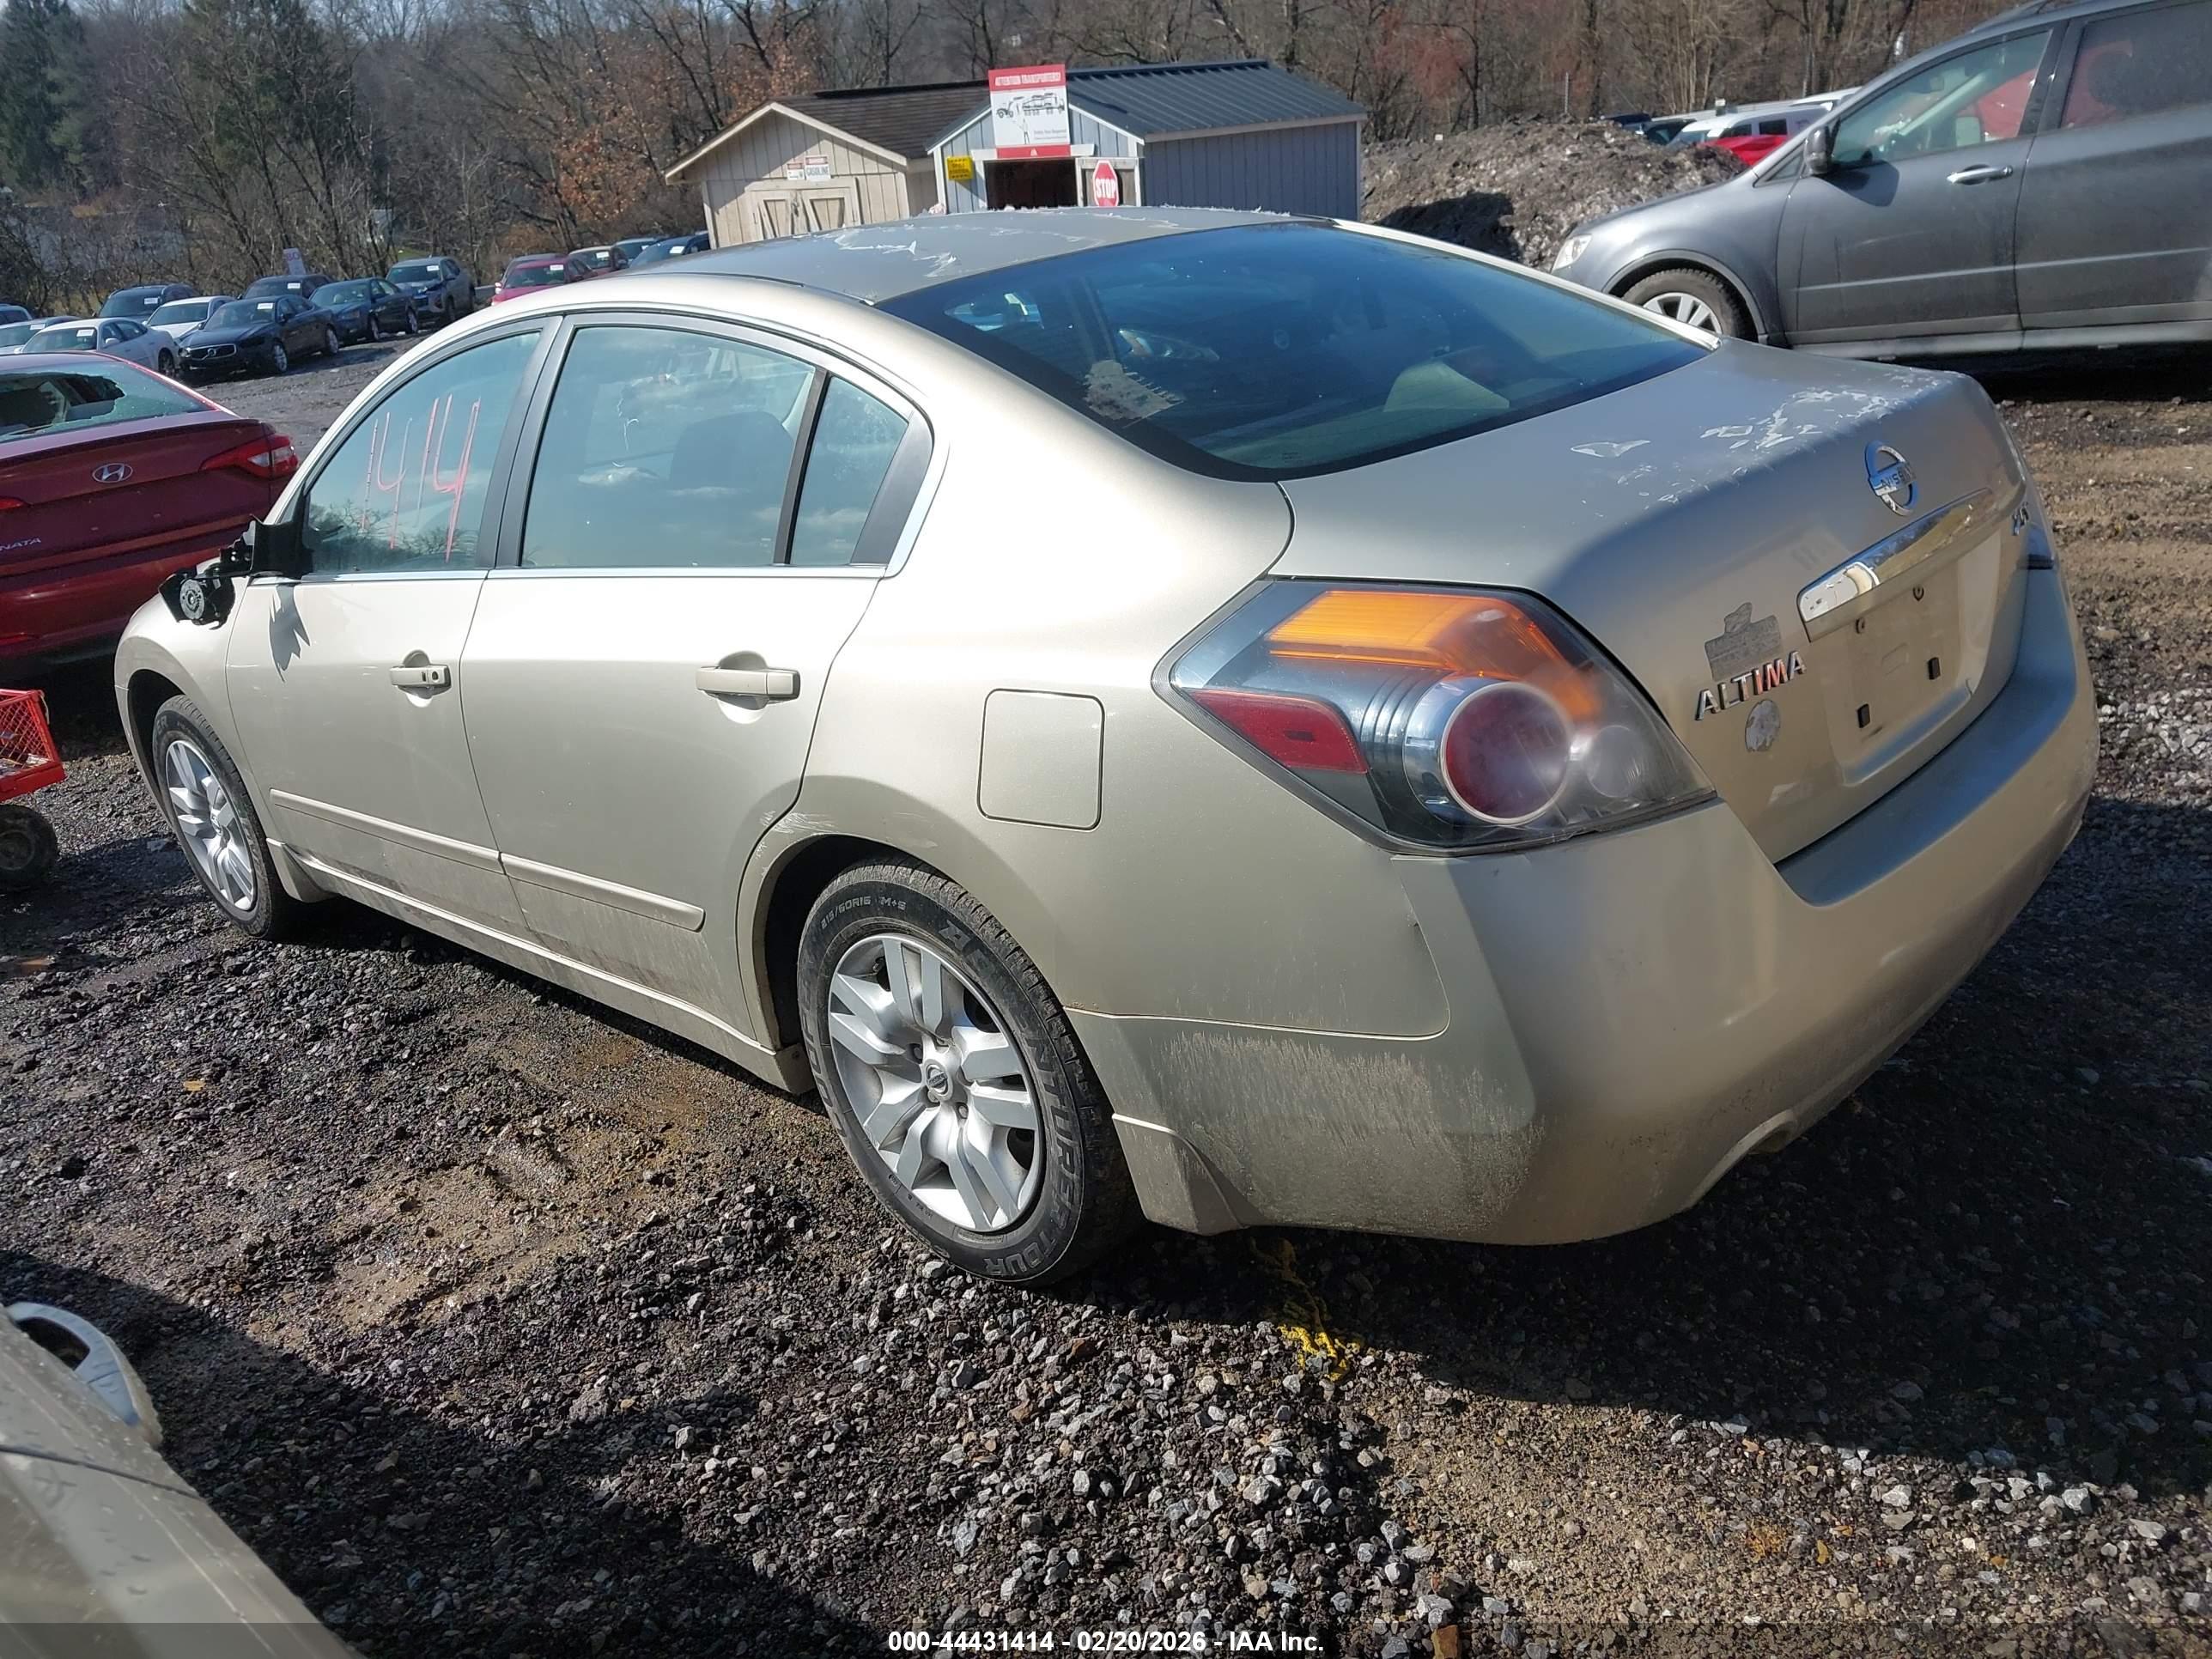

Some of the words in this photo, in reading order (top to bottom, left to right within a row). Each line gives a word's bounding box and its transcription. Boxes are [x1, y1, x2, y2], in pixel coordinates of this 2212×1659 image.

[1095, 178, 1116, 198] STOP
[1694, 650, 1807, 721] ALTIMA
[821, 896, 872, 929] 215/60R16
[880, 896, 906, 911] M+S
[984, 1230, 1058, 1277] TOUR
